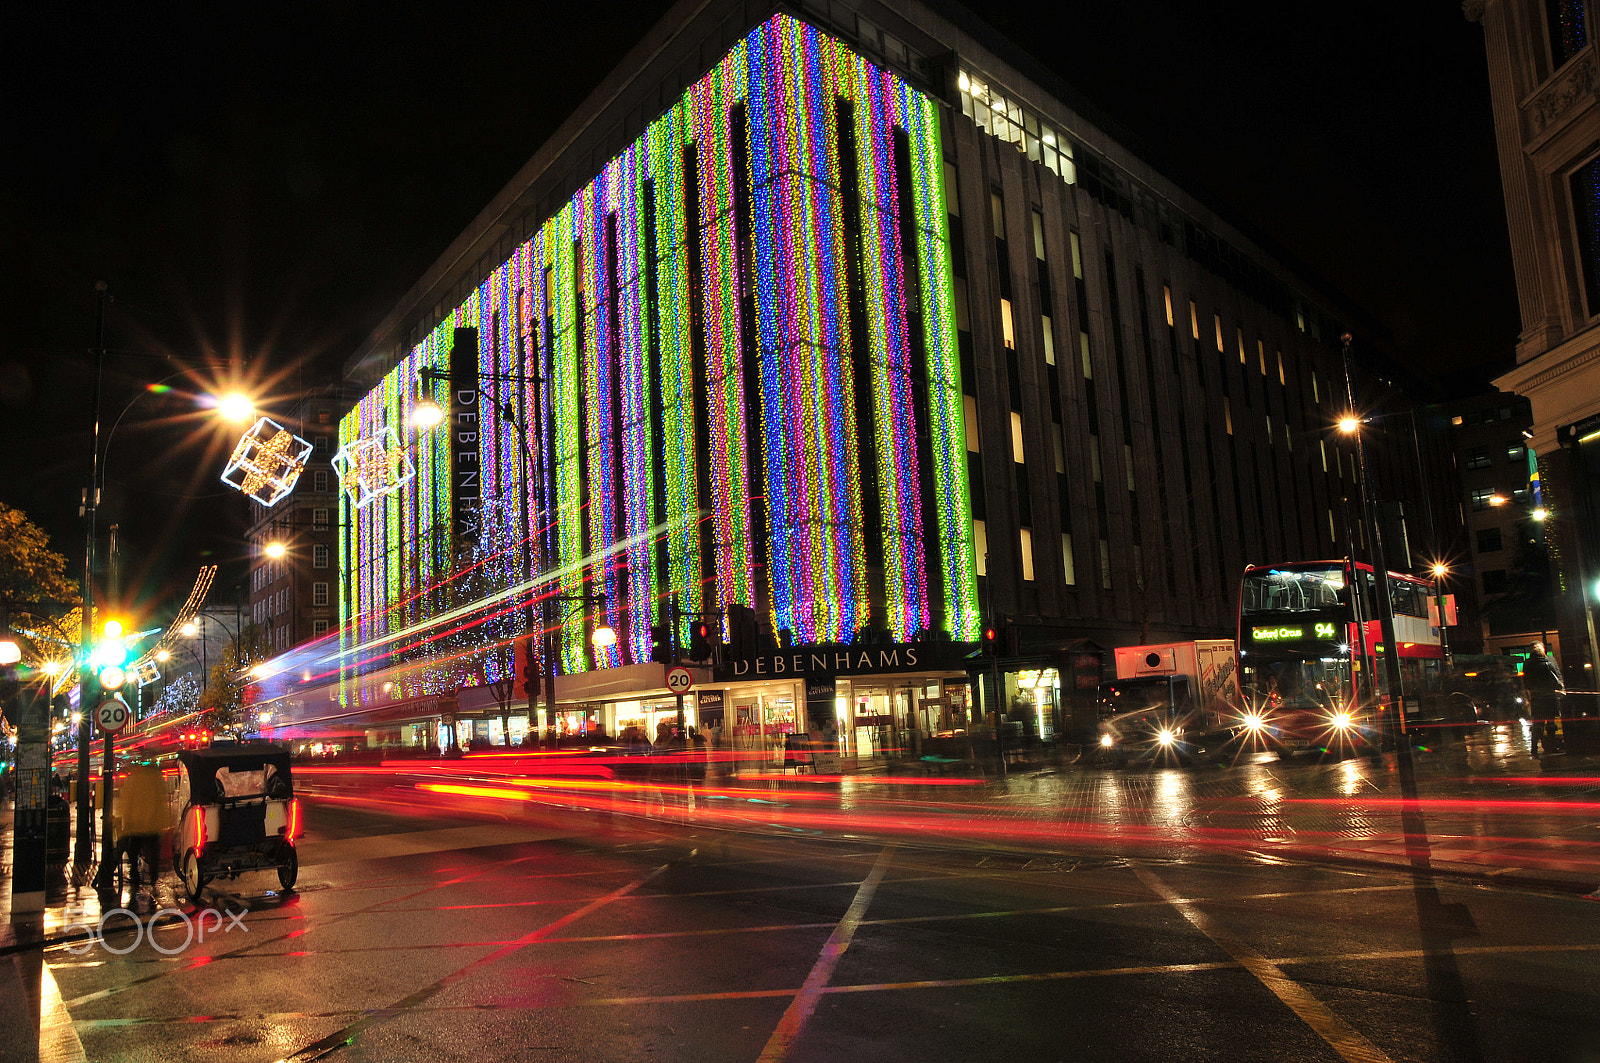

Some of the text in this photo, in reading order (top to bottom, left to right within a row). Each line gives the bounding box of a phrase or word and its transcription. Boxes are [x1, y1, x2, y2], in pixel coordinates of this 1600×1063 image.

[1253, 627, 1302, 640] Oxford Circus
[1315, 622, 1335, 638] 94
[734, 648, 918, 675] DEBENHAMS
[670, 674, 689, 687] 20
[101, 708, 125, 723] 20
